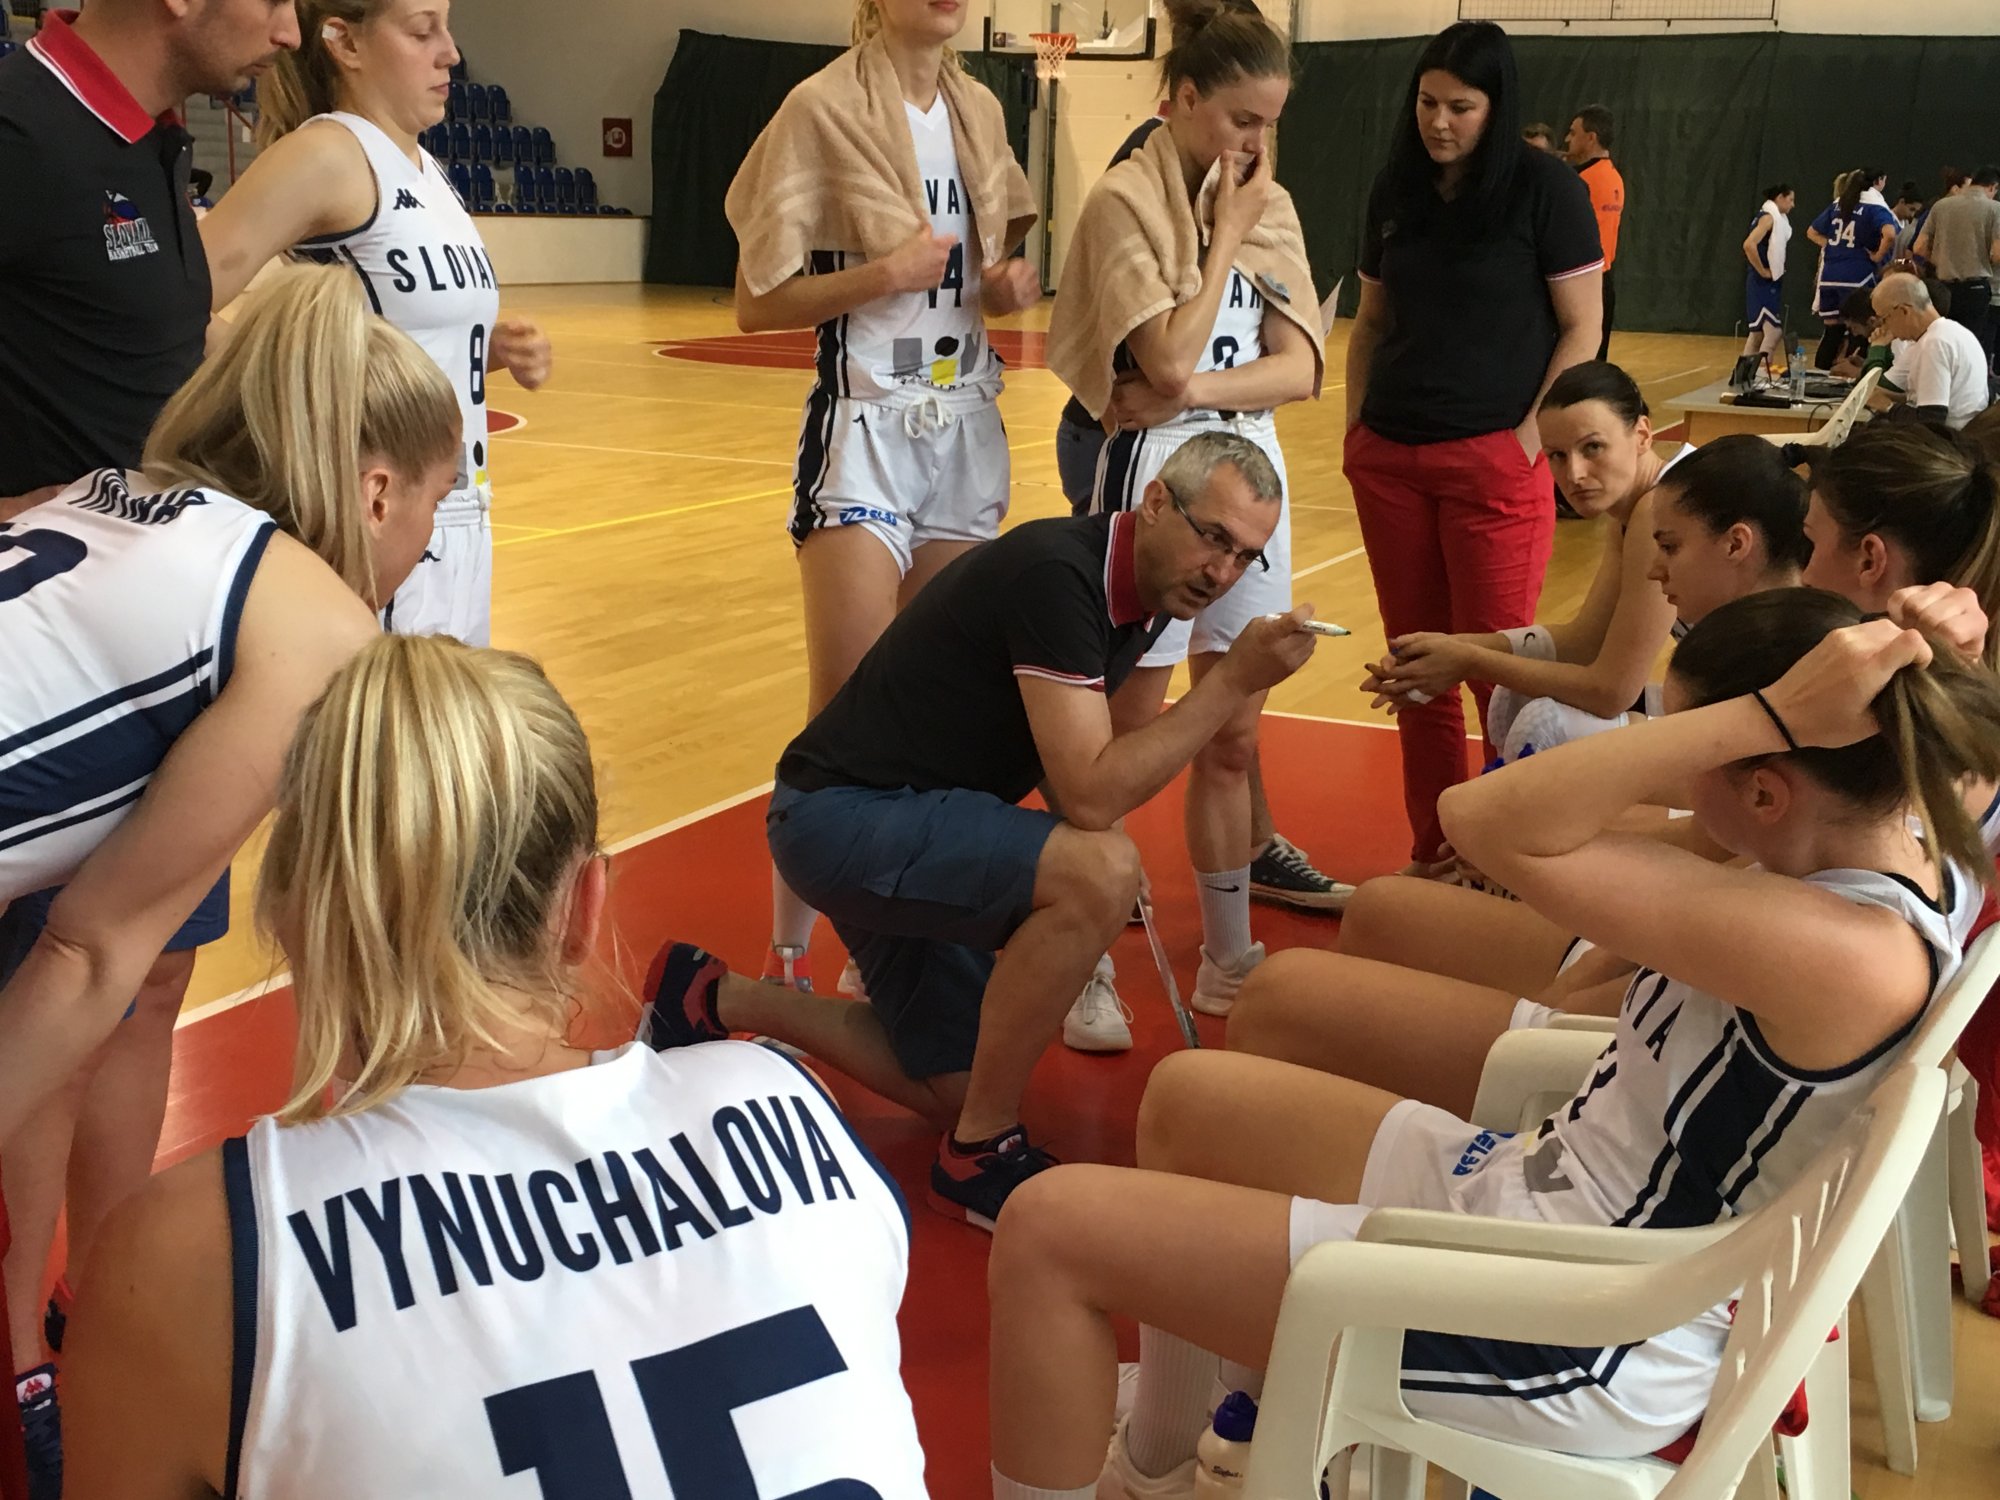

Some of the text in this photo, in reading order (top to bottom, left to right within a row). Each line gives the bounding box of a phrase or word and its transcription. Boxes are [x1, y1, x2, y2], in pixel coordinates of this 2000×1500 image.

[1828, 217, 1856, 248] 34
[470, 323, 485, 405] 8
[287, 1095, 857, 1333] VYNUCHALOVA
